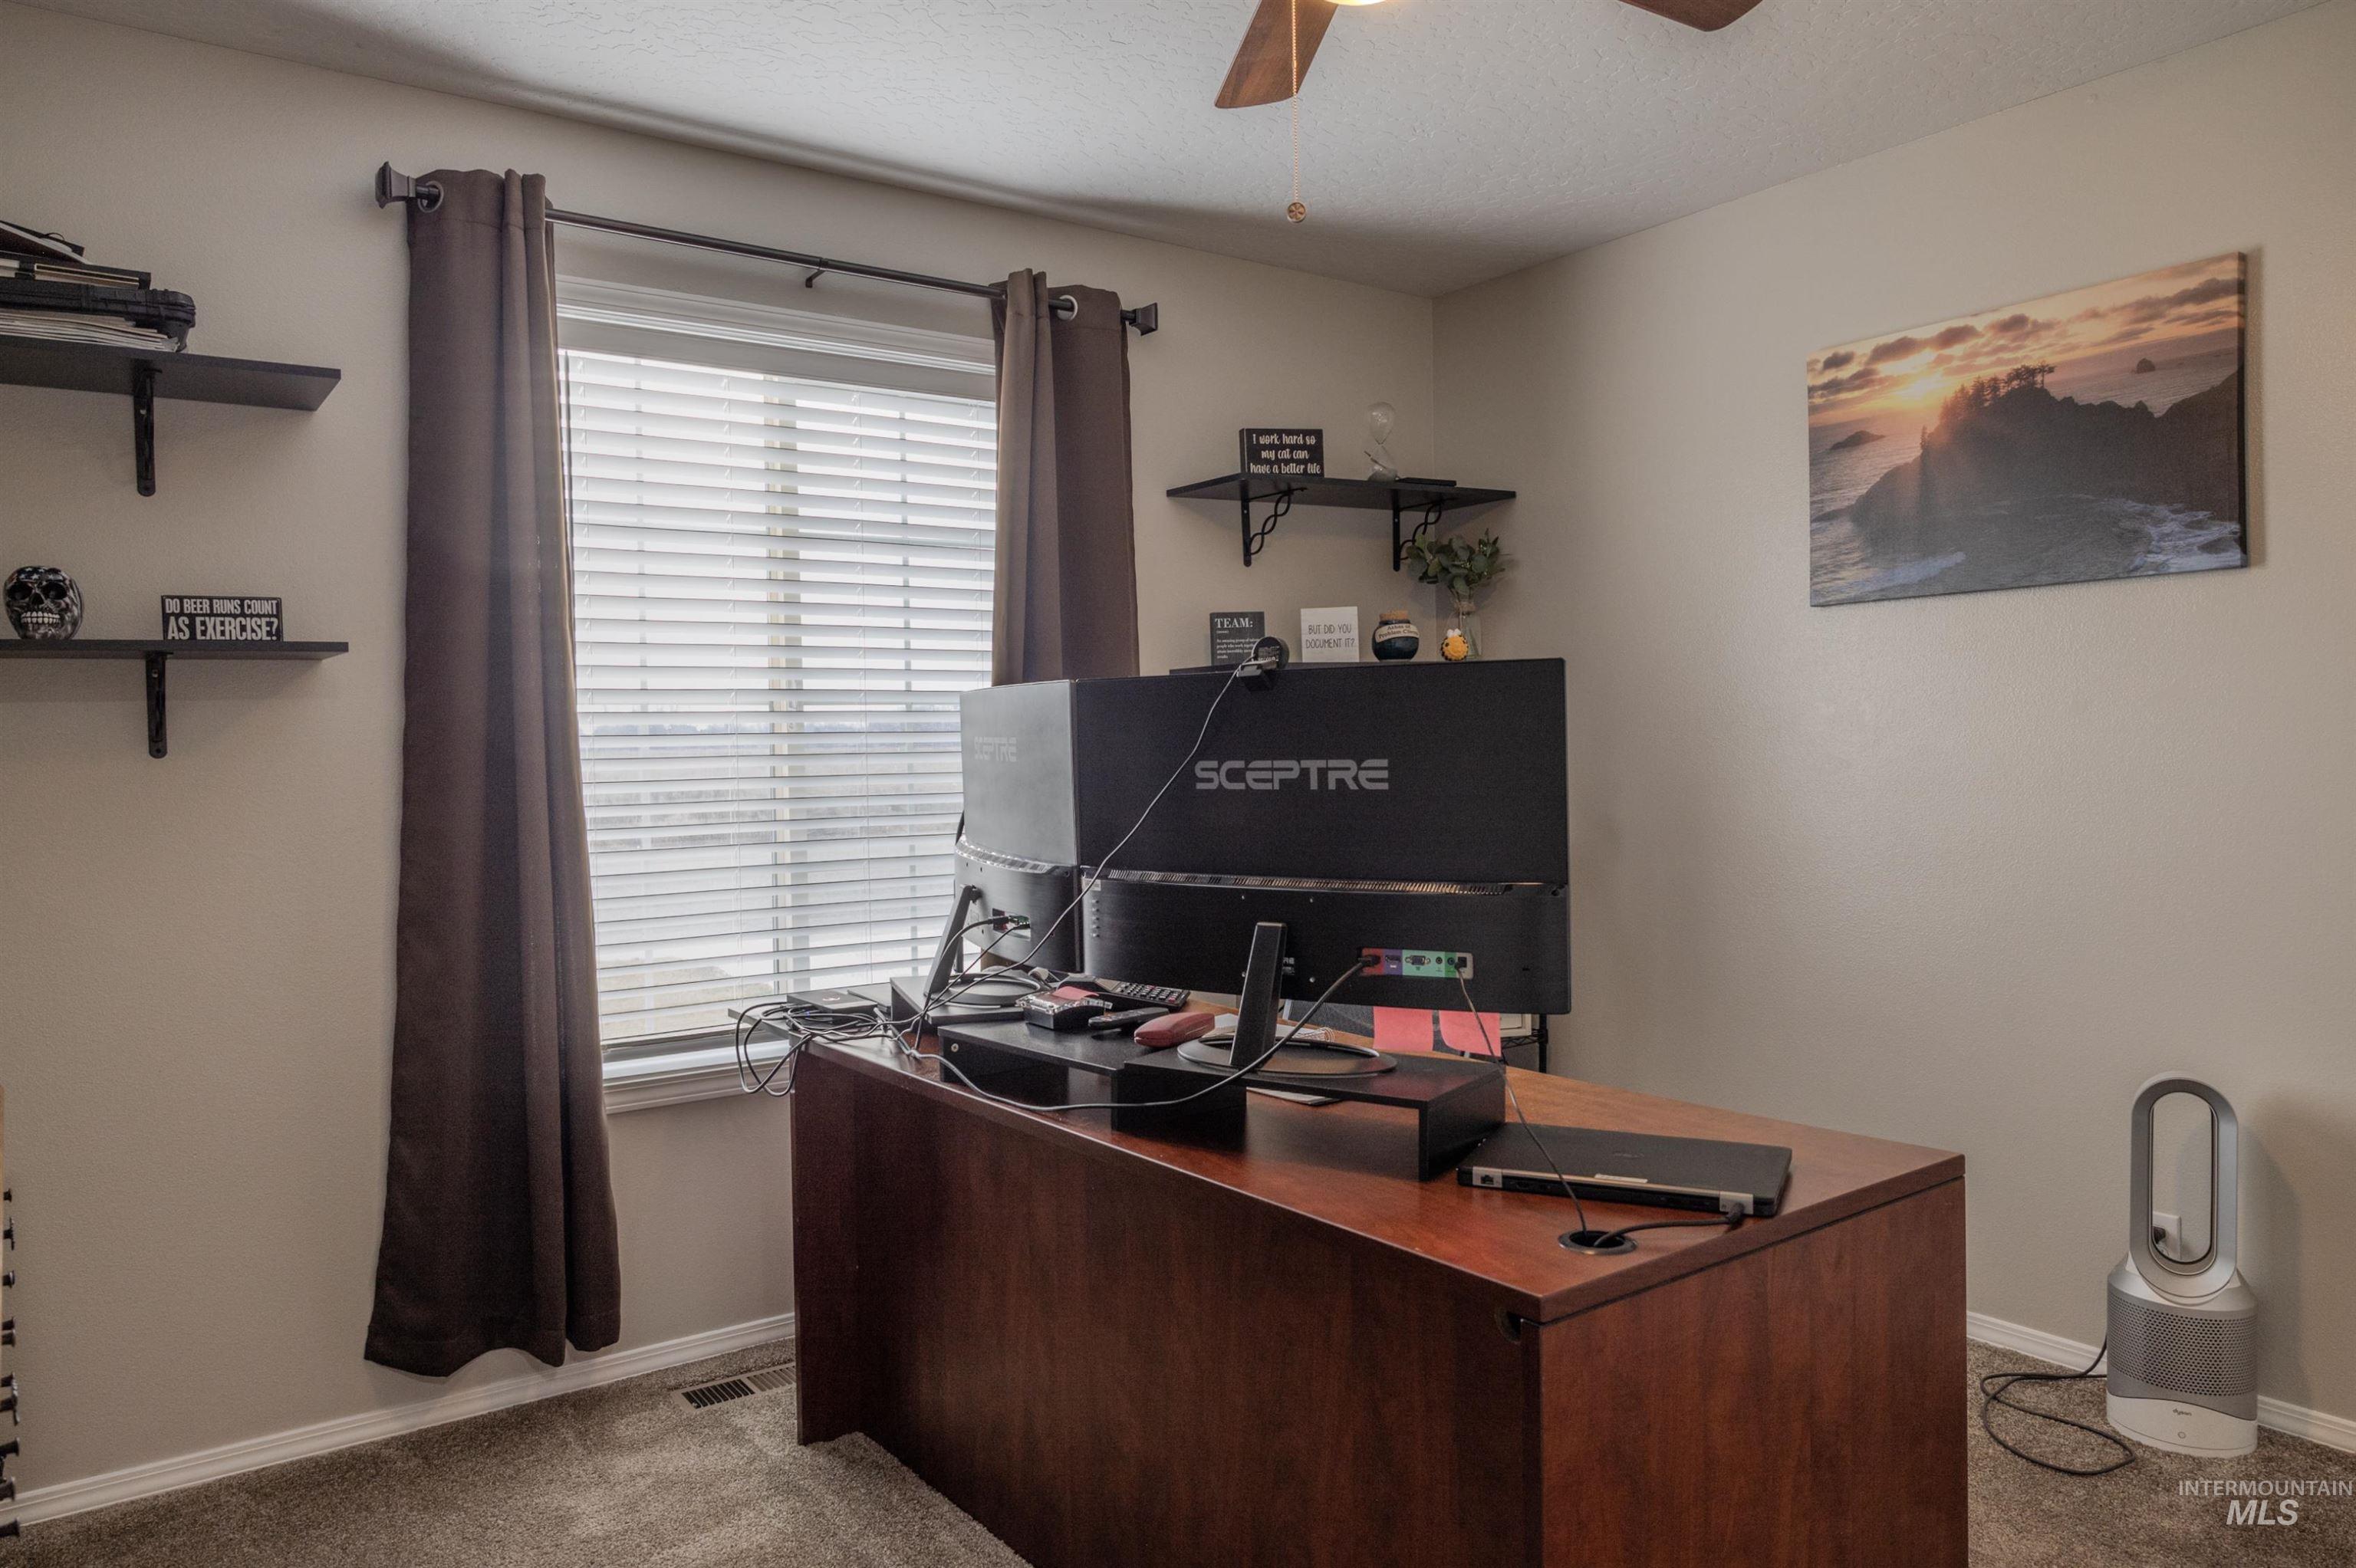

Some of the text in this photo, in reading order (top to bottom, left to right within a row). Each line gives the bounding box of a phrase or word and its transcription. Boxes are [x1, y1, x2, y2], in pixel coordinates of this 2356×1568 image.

[1252, 434, 1317, 445] I work hard so
[1261, 449, 1309, 460] my cat can
[1250, 463, 1321, 473] have a better life
[165, 598, 277, 614] DO BEER RUNS COUNT
[167, 616, 278, 641] AS EXERCISE?
[1215, 618, 1253, 628] TEAM:
[1308, 623, 1351, 635] BUT DID YOU
[1305, 638, 1355, 649] DOCUMENT IT?
[974, 736, 1017, 762] SCEPTRE
[1195, 759, 1390, 790] SCEPTRE
